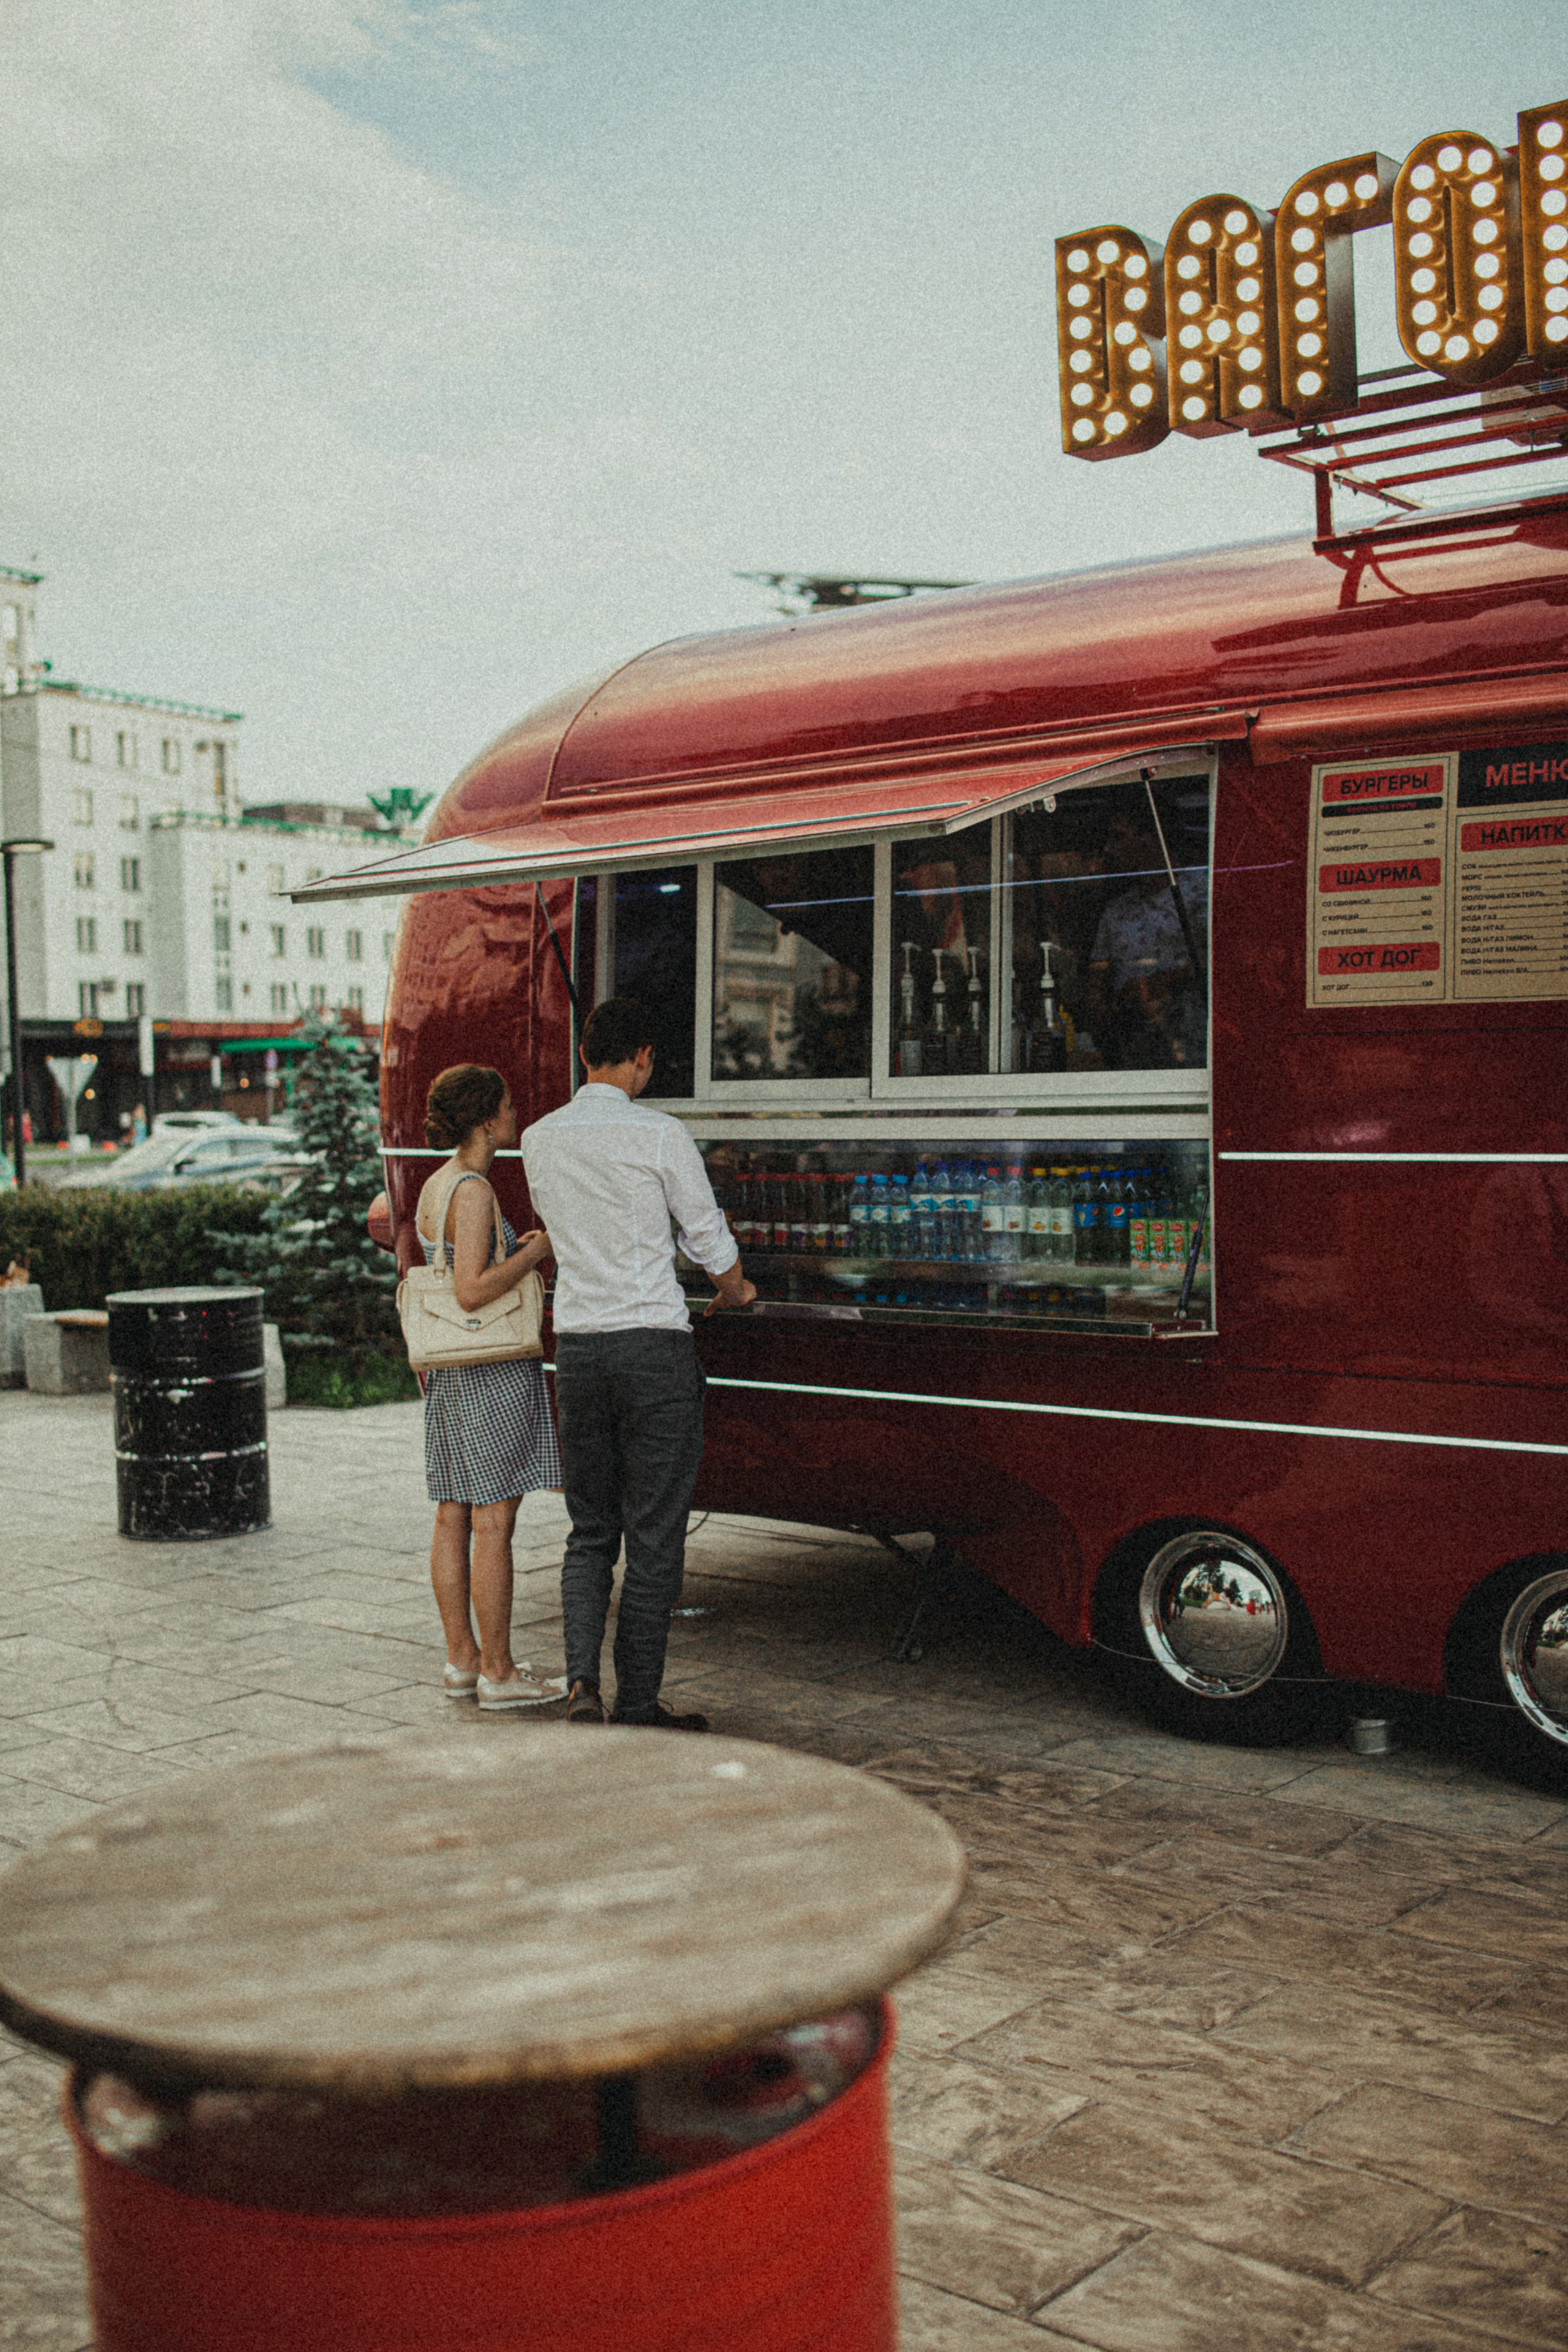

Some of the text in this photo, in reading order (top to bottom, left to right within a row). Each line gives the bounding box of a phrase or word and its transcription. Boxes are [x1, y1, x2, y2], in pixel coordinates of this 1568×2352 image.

[1340, 772, 1428, 796] БУРГЕРЫ
[1346, 804, 1378, 813] котлета
[1480, 823, 1568, 845] НАПИТК
[1336, 865, 1422, 886] ШАУРМА
[1461, 891, 1545, 902] МОЛОЧНЫЙ КОКТЕЙЛЬ
[1337, 949, 1421, 968] ХОТ ДОГ
